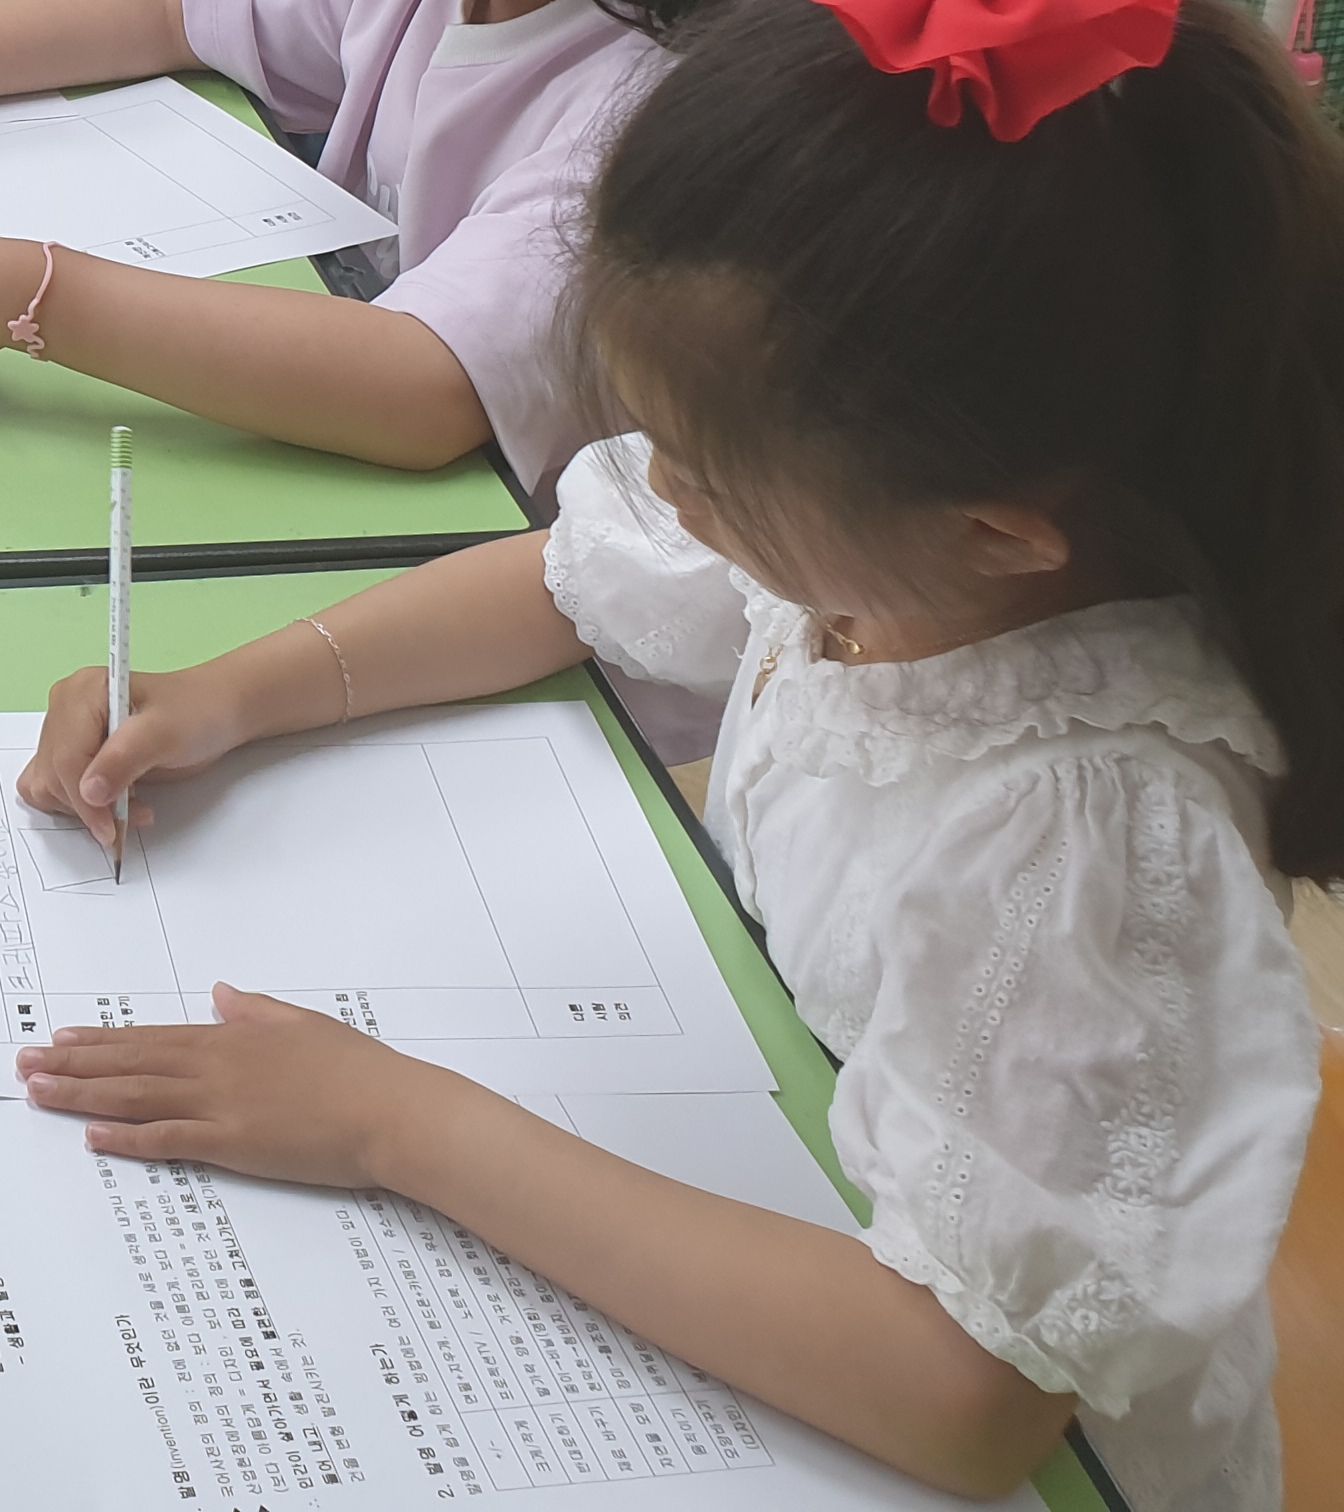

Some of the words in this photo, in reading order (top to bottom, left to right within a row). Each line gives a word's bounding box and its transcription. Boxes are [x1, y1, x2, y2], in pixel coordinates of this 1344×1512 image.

[17, 1004, 32, 1014] 목
[568, 1003, 584, 1021] 다른
[591, 1002, 607, 1020] 사람
[613, 1002, 631, 1020] 의견
[108, 1195, 130, 1227] 내거나
[179, 1192, 198, 1213] 새로
[191, 1221, 210, 1242] 것을
[215, 1215, 246, 1270] 고쳐나가는
[123, 1233, 146, 1265] 생각해
[153, 1249, 173, 1270] 보다
[348, 1236, 374, 1270] 방법이
[138, 1271, 156, 1293] 새로
[181, 1256, 210, 1300] 편리하게
[238, 1277, 259, 1299] 점을
[366, 1276, 387, 1298] 가지
[149, 1300, 169, 1322] 것을
[202, 1307, 222, 1329] 보다
[226, 1307, 246, 1329] 따라
[252, 1306, 276, 1339] 불편한
[380, 1305, 401, 1328] 여러
[0, 1310, 24, 1348] 생활과
[114, 1314, 145, 1368] 무엇인가
[187, 1332, 207, 1355] 보다
[217, 1346, 242, 1381] 디자인
[238, 1336, 264, 1371] 필요에
[269, 1347, 292, 1382] 속에서
[369, 1343, 399, 1384] 하는가
[397, 1335, 428, 1383] 방법에는
[171, 1358, 192, 1382] 전에
[202, 1372, 223, 1396] 정의
[301, 1355, 336, 1417] 발전시키는
[188, 1400, 208, 1425] 정의
[256, 1379, 293, 1441] 살아가면서
[288, 1391, 308, 1415] 생활
[392, 1393, 424, 1437] 어떻게
[424, 1391, 442, 1415] 하는
[328, 1425, 350, 1449] 변형
[587, 1405, 616, 1441] 바꾸기
[215, 1404, 262, 1494] 산업현장에서의
[416, 1446, 443, 1475] 발명
[200, 1433, 233, 1496] 국어사전의
[264, 1461, 288, 1492] (보다
[285, 1450, 313, 1489] 인간이
[452, 1456, 482, 1495] 발명을
[437, 1483, 454, 1498] 2.
